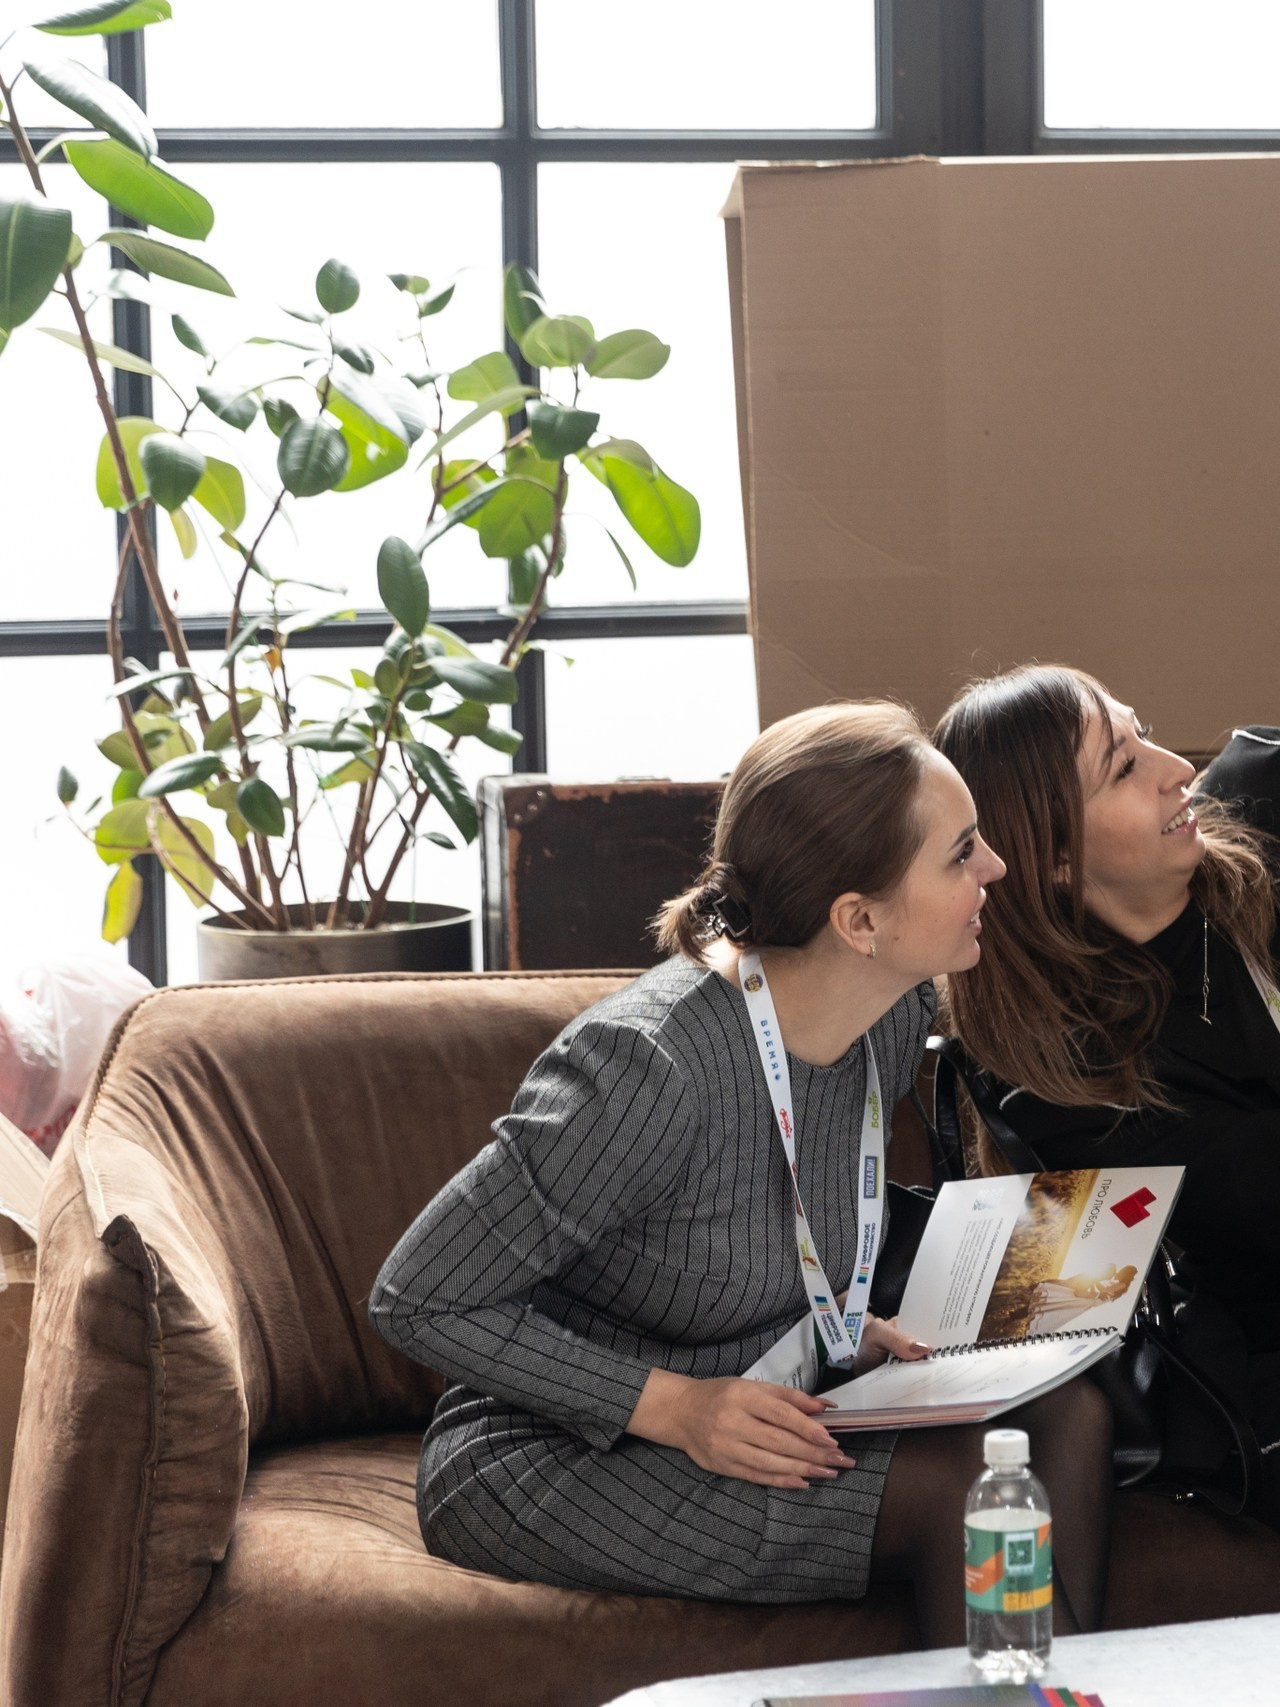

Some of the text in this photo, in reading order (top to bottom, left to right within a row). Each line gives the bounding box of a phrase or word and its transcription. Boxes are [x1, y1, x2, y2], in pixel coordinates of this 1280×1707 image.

[760, 1019, 779, 1070] ВРЕМЯ
[865, 1158, 876, 1196] ПОЕХАЛИ!
[1081, 1179, 1112, 1239] ПРО ЛЮБОВЬ
